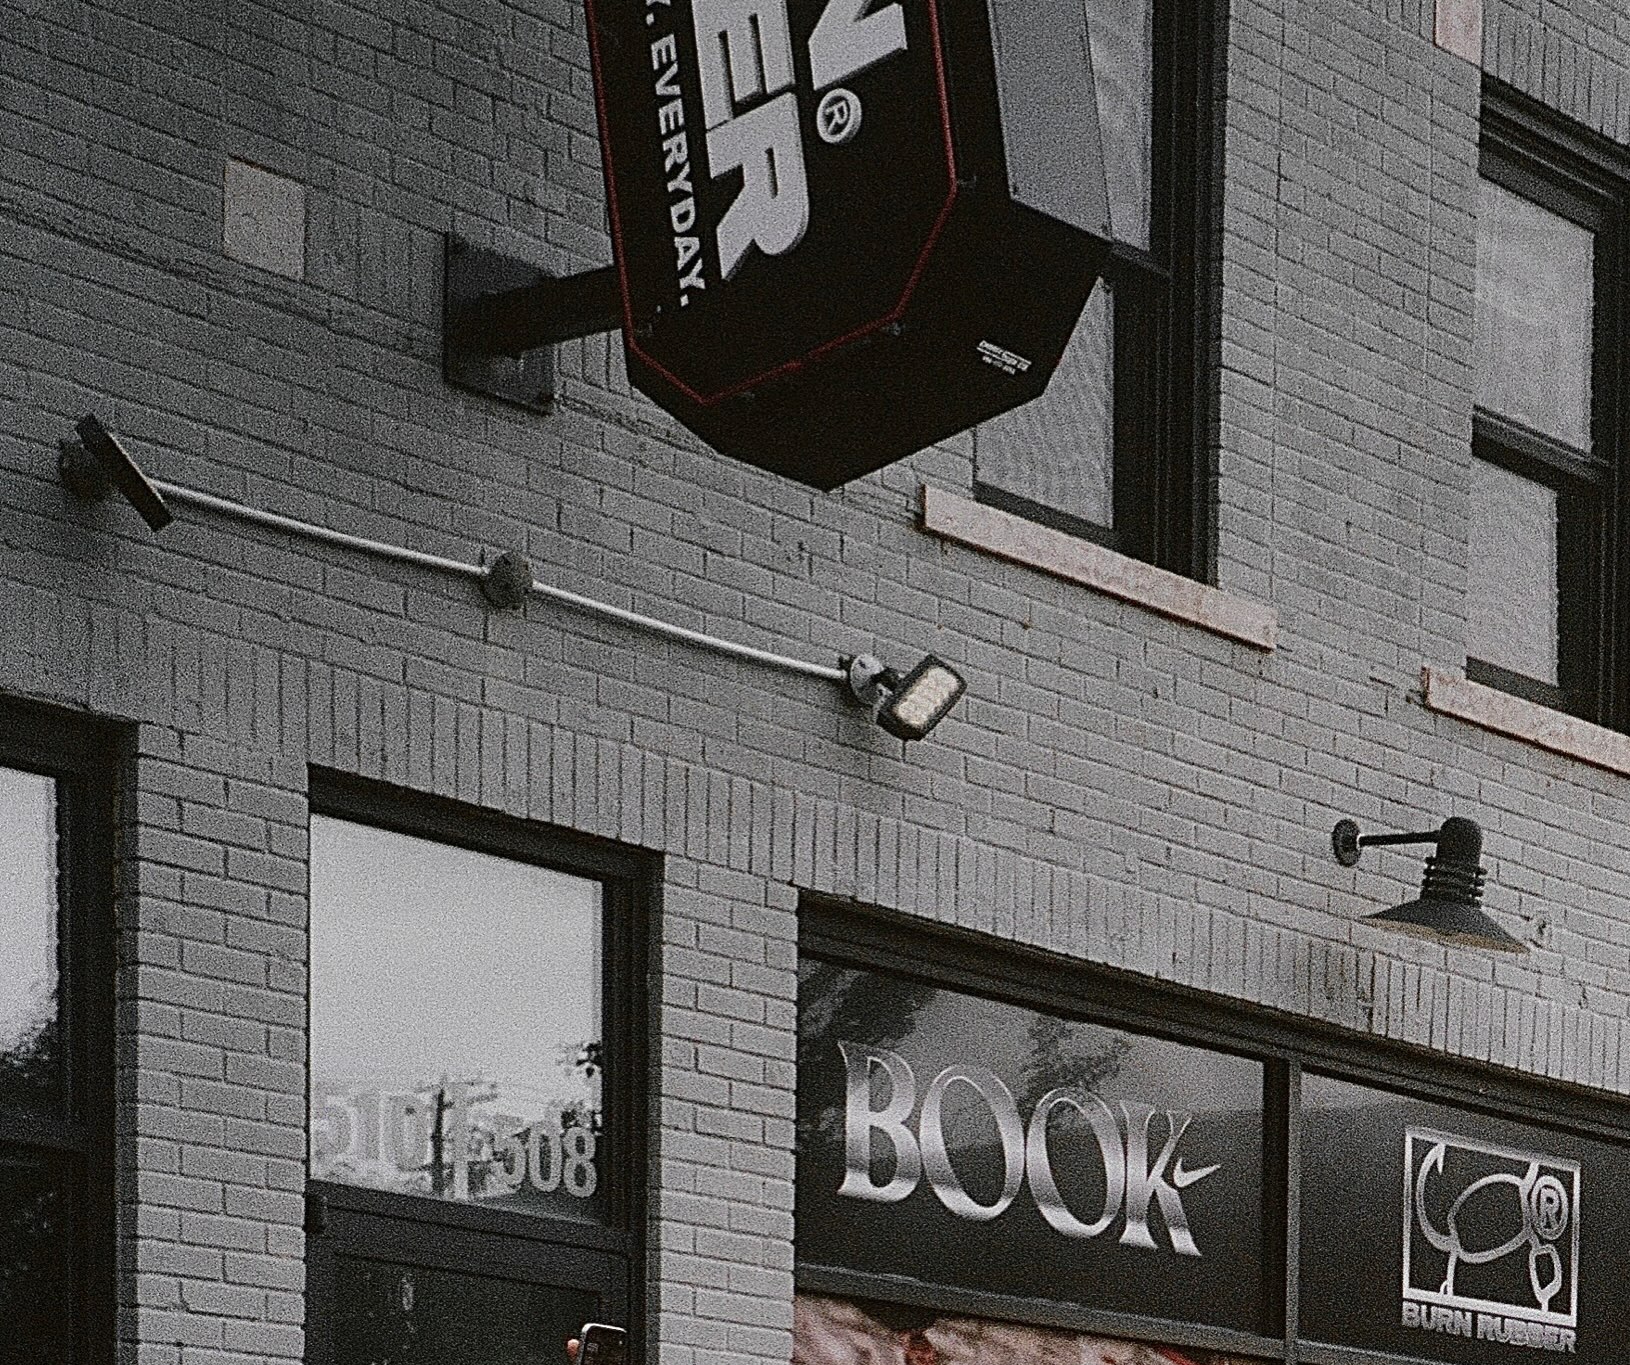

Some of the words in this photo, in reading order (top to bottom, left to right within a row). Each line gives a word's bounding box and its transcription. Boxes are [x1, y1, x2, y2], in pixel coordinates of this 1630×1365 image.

[650, 33, 706, 307] EVERYDAY.
[837, 1041, 1202, 1257] BOOK
[1401, 1300, 1473, 1338] BURN
[1476, 1313, 1577, 1354] RUBBER
